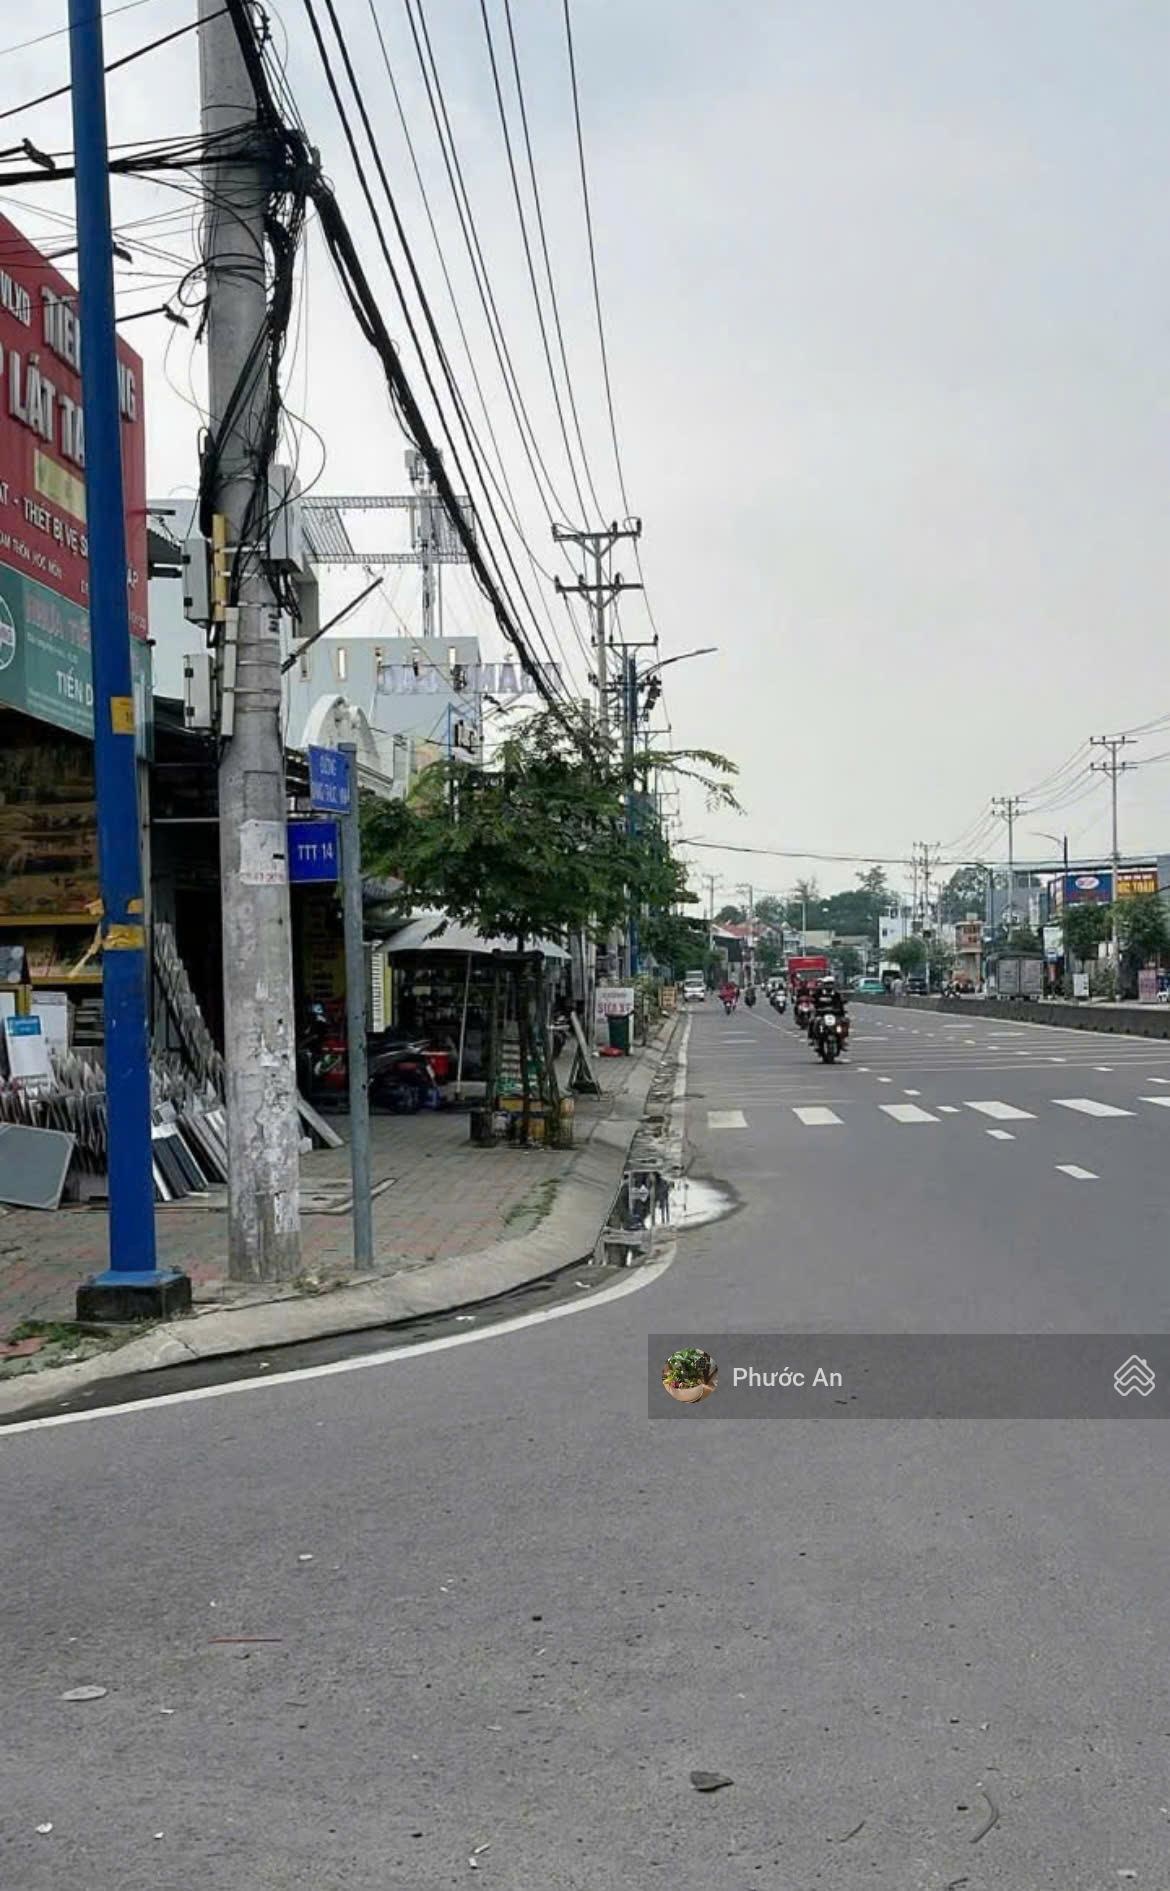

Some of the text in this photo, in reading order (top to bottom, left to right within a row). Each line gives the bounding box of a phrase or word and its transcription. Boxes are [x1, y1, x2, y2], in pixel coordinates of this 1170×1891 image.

[86, 683, 94, 706] D
[298, 842, 334, 861] TTT 14
